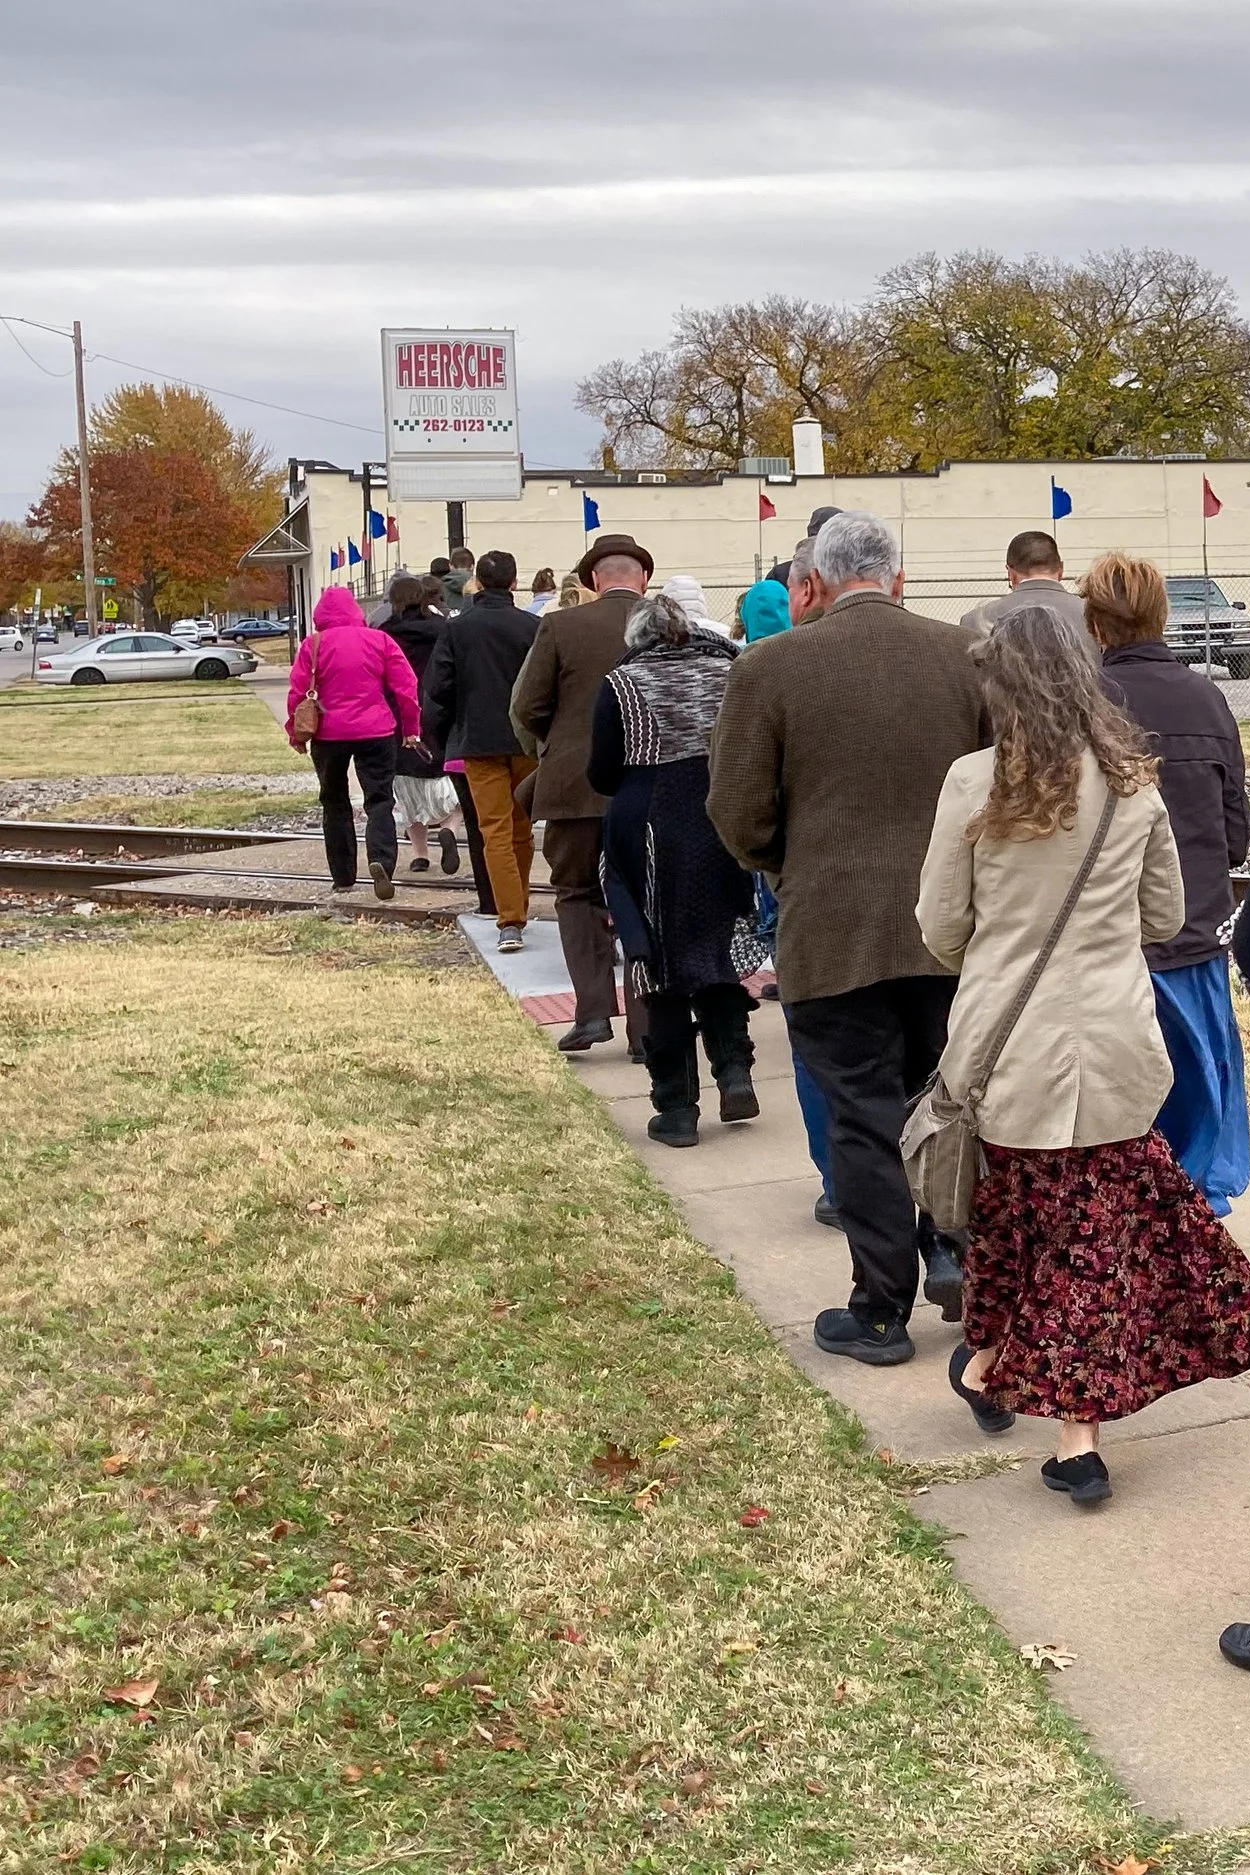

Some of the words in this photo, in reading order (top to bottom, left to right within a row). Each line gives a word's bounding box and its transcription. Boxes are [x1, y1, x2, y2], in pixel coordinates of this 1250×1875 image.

[396, 341, 506, 390] HEERSCHE
[409, 395, 447, 416] AUTO
[452, 395, 496, 416] SALES
[423, 419, 484, 432] 262-0123
